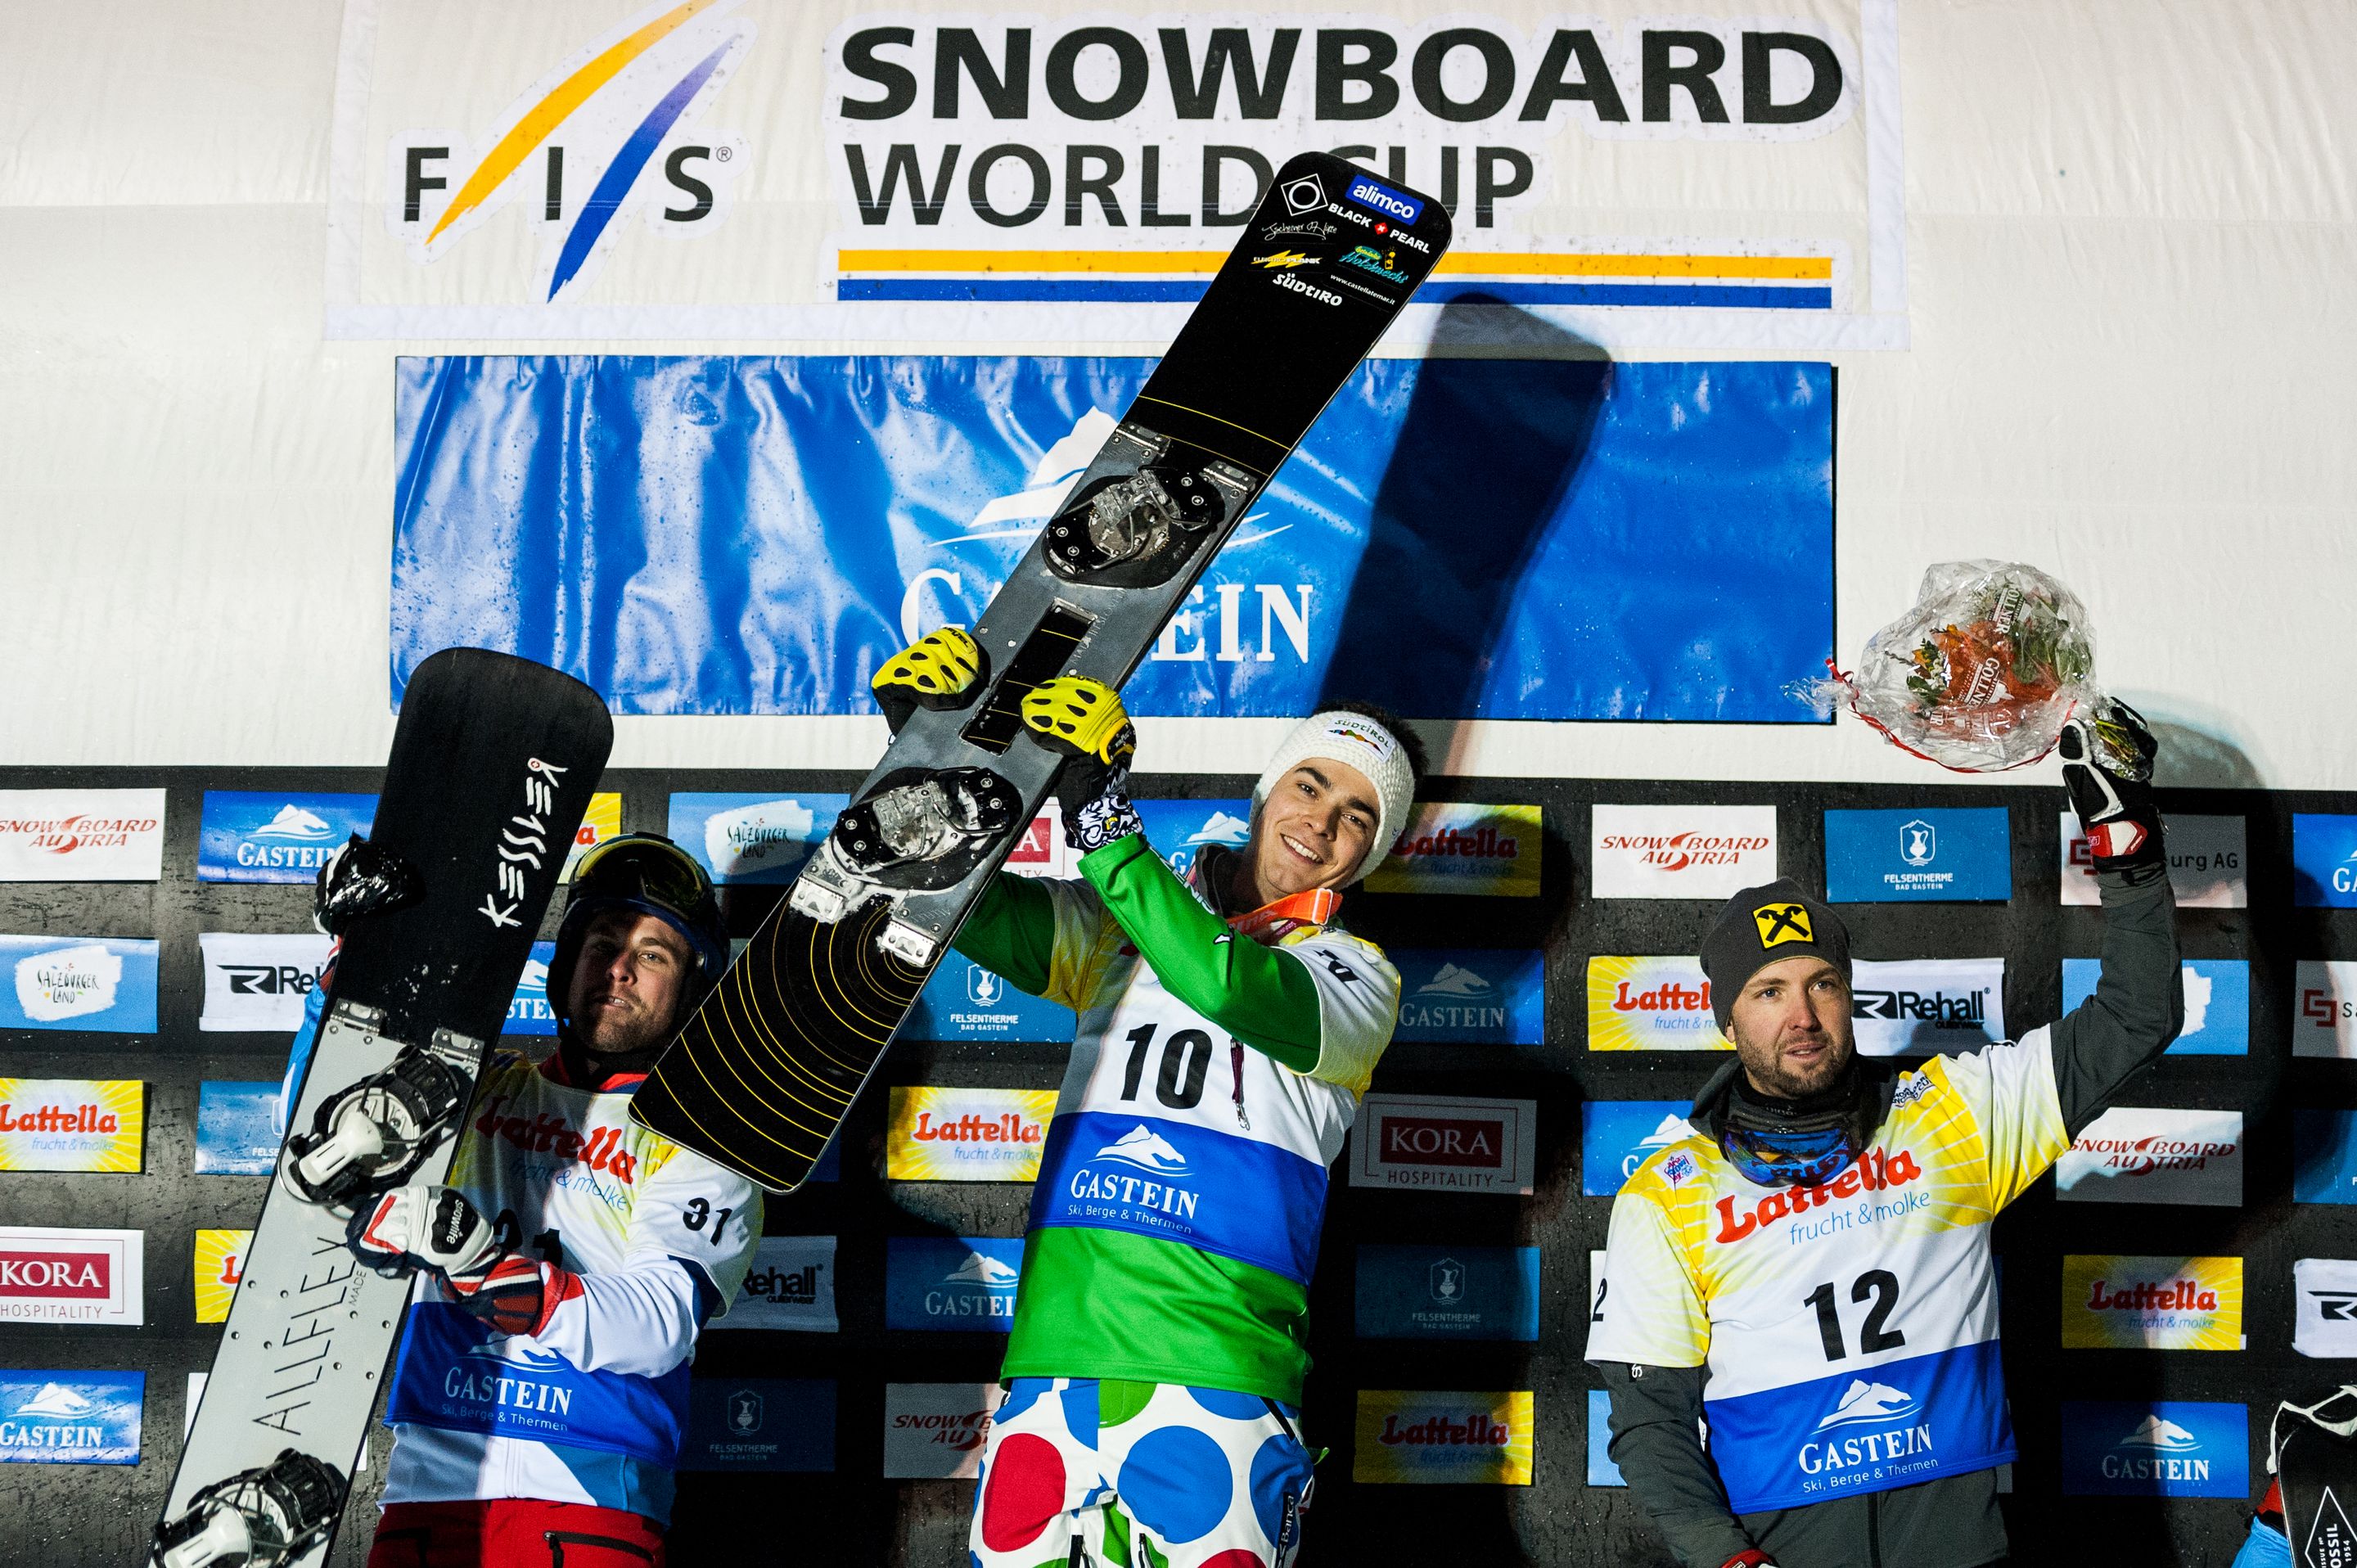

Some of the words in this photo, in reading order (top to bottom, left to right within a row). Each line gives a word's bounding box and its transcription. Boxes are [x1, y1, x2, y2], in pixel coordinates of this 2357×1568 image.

[840, 26, 1842, 123] SNOWBOARD
[404, 146, 714, 222] FIS
[843, 143, 1275, 229] WORLD
[1330, 146, 1533, 229] UP
[1353, 182, 1415, 221] alimco
[1328, 201, 1372, 228] BLACK
[1390, 228, 1430, 255] PEARL
[900, 568, 1313, 664] GEIN
[1967, 657, 1999, 709] GOLLNE
[1393, 827, 1518, 859] Lattella
[2214, 853, 2238, 869] AG
[1884, 873, 1954, 884] FELSENTHERME
[52, 987, 76, 1004] LAND
[1613, 982, 1712, 1012] Lattel
[1900, 991, 1984, 1020] Rehall
[951, 1014, 1019, 1025] FELSENTHERME
[1399, 1003, 1505, 1029] GASTEIN
[1655, 1016, 1689, 1032] frucht
[1692, 1017, 1701, 1030] &
[1120, 1023, 1213, 1110] 10
[0, 1104, 118, 1133] Lattella
[913, 1113, 1042, 1143] Lattella
[32, 1138, 67, 1152] frucht
[475, 1095, 638, 1184] Lattella
[954, 1147, 989, 1160] frucht
[993, 1149, 1001, 1160] &
[1003, 1147, 1039, 1162] molke
[1390, 1127, 1494, 1156] KORA
[557, 1169, 571, 1187] &
[574, 1174, 627, 1211] molke
[1388, 1169, 1494, 1187] HOSPITALITY
[1070, 1169, 1199, 1219] GASTEIN
[1715, 1147, 1922, 1245] Lattella
[446, 1199, 464, 1245] snowlife
[683, 1197, 732, 1247] 31
[1068, 1204, 1084, 1217] Ski,
[1086, 1205, 1116, 1219] Berge
[1120, 1208, 1129, 1219] &
[1135, 1210, 1192, 1235] Thermen
[1790, 1212, 1854, 1246] frucht
[1859, 1205, 1873, 1225] &
[1876, 1190, 1931, 1221] molke
[0, 1260, 103, 1288] KORA
[348, 1270, 367, 1306] MADE
[926, 1292, 1017, 1317] GASTEI
[2088, 1281, 2218, 1311] Lattella
[1413, 1313, 1481, 1324] FELSENTHERME
[1804, 1269, 1906, 1363] 12
[2129, 1315, 2165, 1329] frucht
[2167, 1317, 2176, 1328] &
[2179, 1316, 2215, 1330] molke
[444, 1367, 572, 1416] GASTEIN
[460, 1406, 493, 1422] Berge
[498, 1411, 506, 1422] &
[511, 1413, 567, 1431] Thermen
[1380, 1415, 1509, 1447] Lattella
[0, 1422, 103, 1449] GASTEIN
[710, 1444, 777, 1453] FELSENTHERME
[1800, 1424, 1932, 1475] GASTEIN
[1803, 1479, 1827, 1494] Ski,
[1831, 1471, 1870, 1491] Berge
[1875, 1468, 1884, 1480] &
[1888, 1458, 1939, 1476] Thermen
[2102, 1455, 2210, 1480] GASTEIN
[1281, 1495, 1294, 1543] Banca
[2326, 1524, 2341, 1568] OSSIL
[2343, 1539, 2353, 1562] 1954
